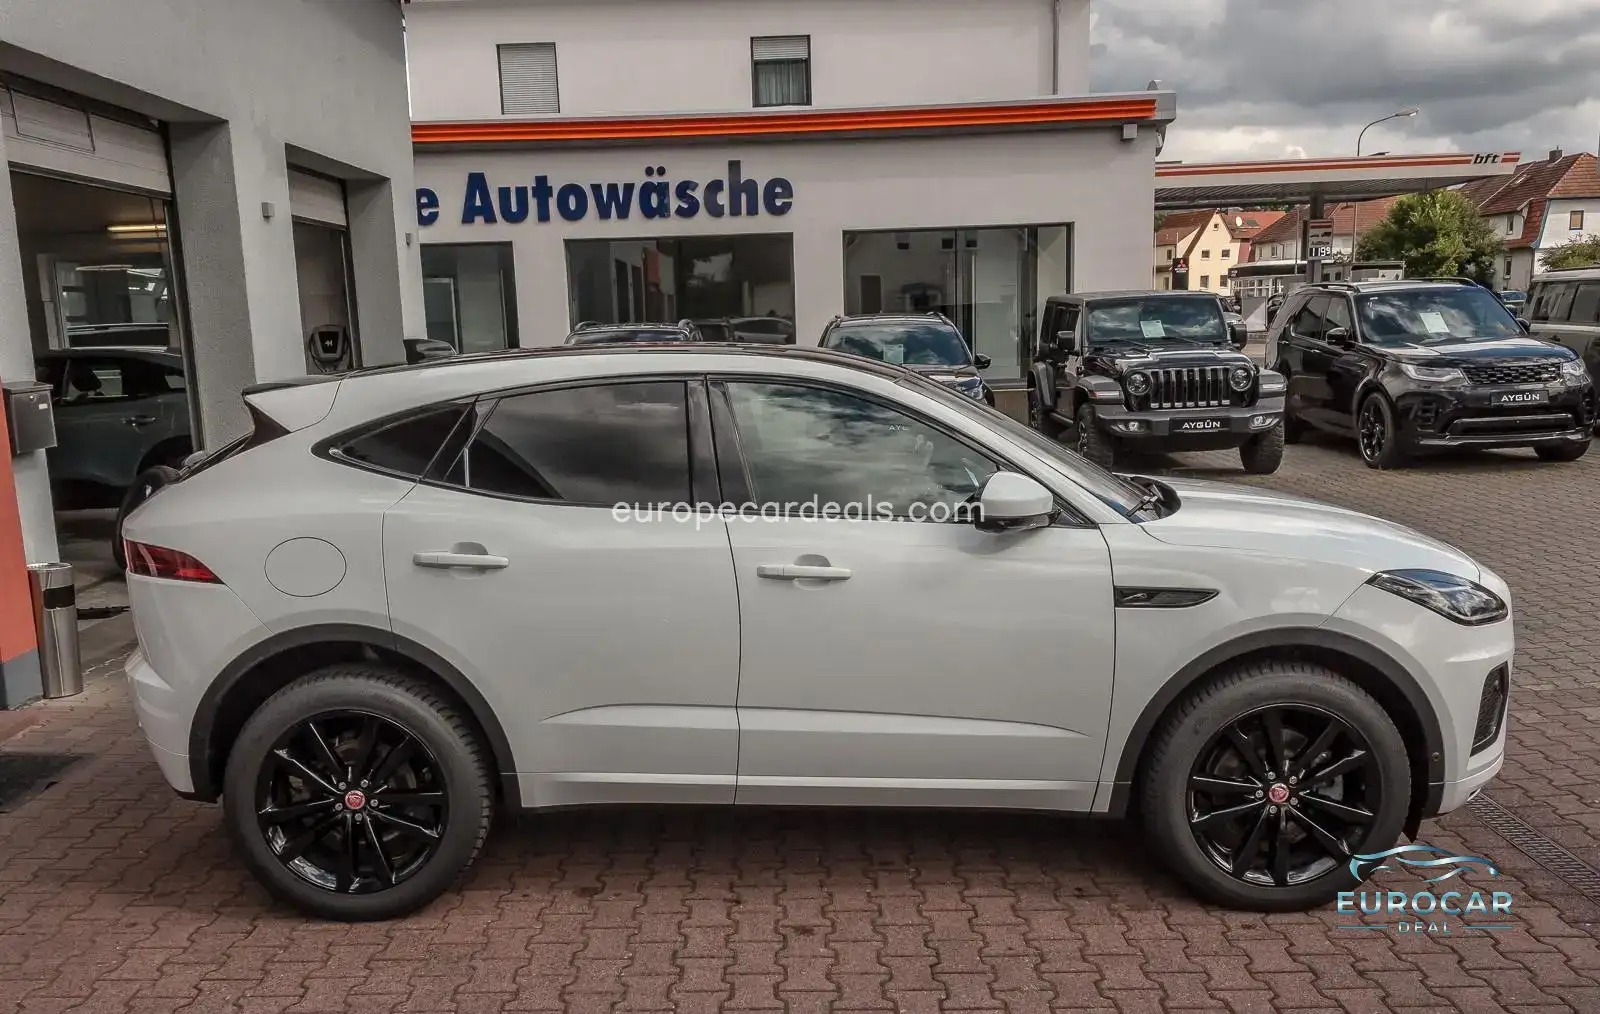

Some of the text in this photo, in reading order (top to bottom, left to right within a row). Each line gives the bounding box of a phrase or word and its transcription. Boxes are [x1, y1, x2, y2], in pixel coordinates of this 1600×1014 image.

[1473, 153, 1500, 164] bft
[461, 160, 794, 225] Autowäsche
[1500, 392, 1540, 402] AYGÜN
[1182, 419, 1220, 429] AYGÜN
